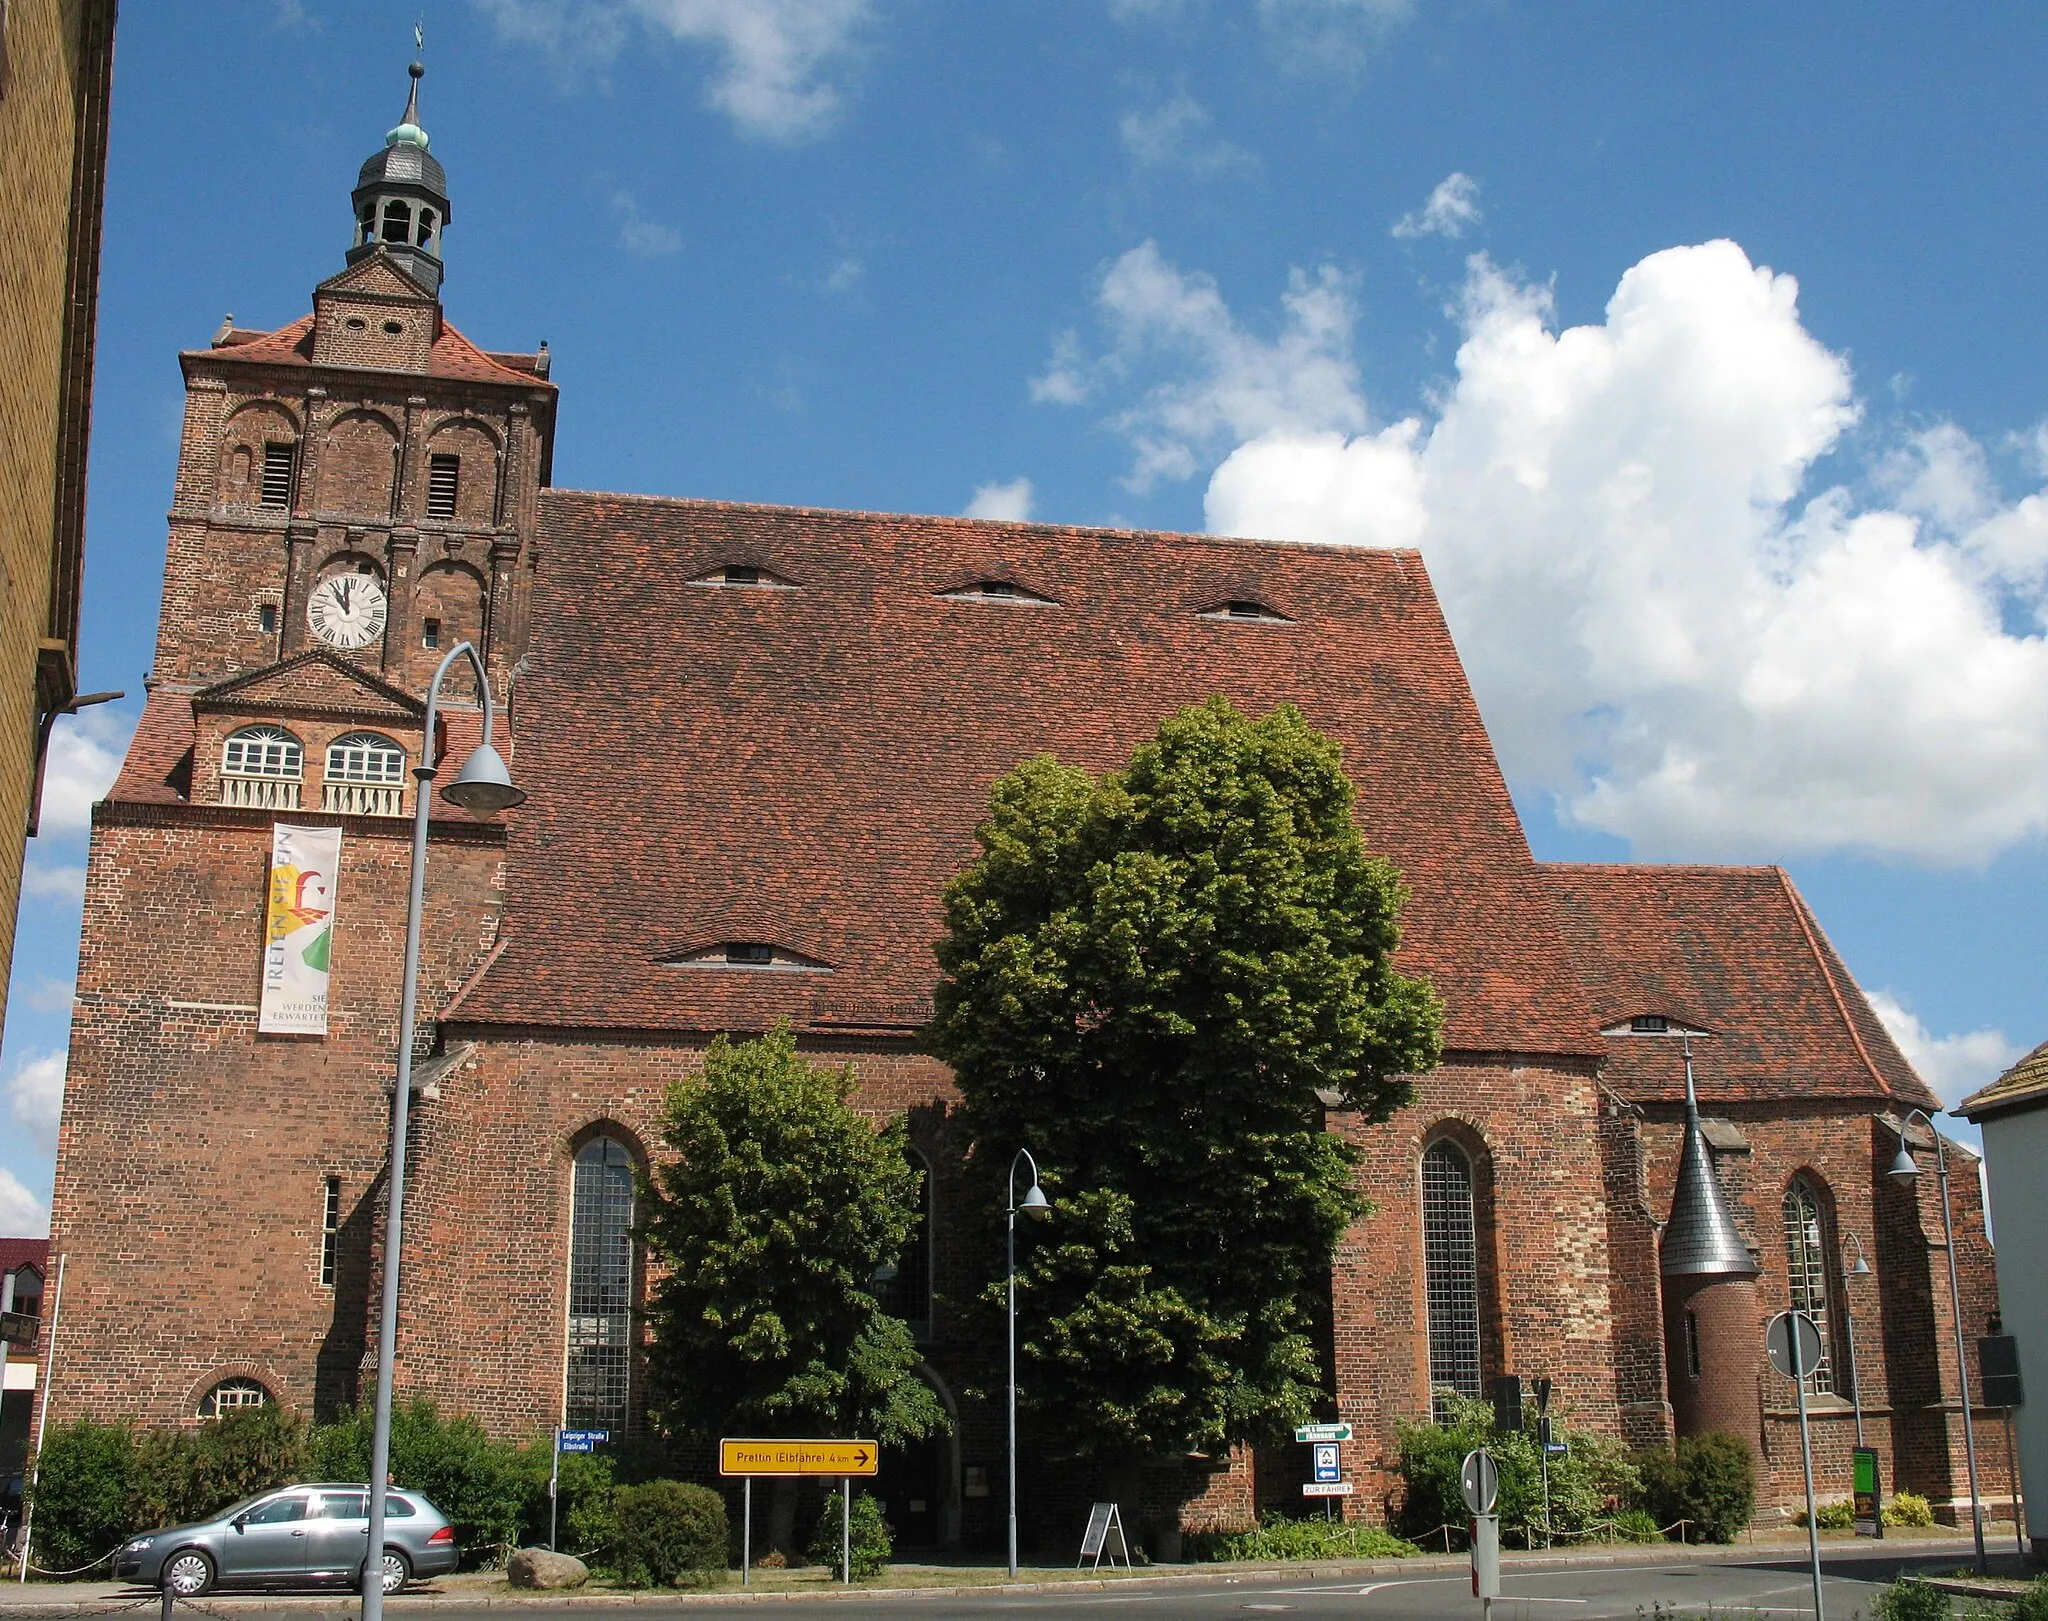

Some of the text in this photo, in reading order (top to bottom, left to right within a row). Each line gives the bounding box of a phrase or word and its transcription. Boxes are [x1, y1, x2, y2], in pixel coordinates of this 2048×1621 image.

[370, 595, 382, 604] II
[373, 610, 384, 618] III
[267, 831, 293, 993] TRETEN SIE EIN
[312, 994, 326, 1003] SIE
[282, 1003, 326, 1012] WERDEN
[272, 1012, 326, 1021] ERWARTET
[562, 1432, 605, 1441] Leipziger Straße
[563, 1442, 589, 1450] Elbstraße
[736, 1452, 772, 1462] Prettin
[776, 1452, 825, 1463] (Elbfähre)
[829, 1453, 836, 1462] 4
[1305, 1485, 1346, 1494] ZUR FÄHRE
